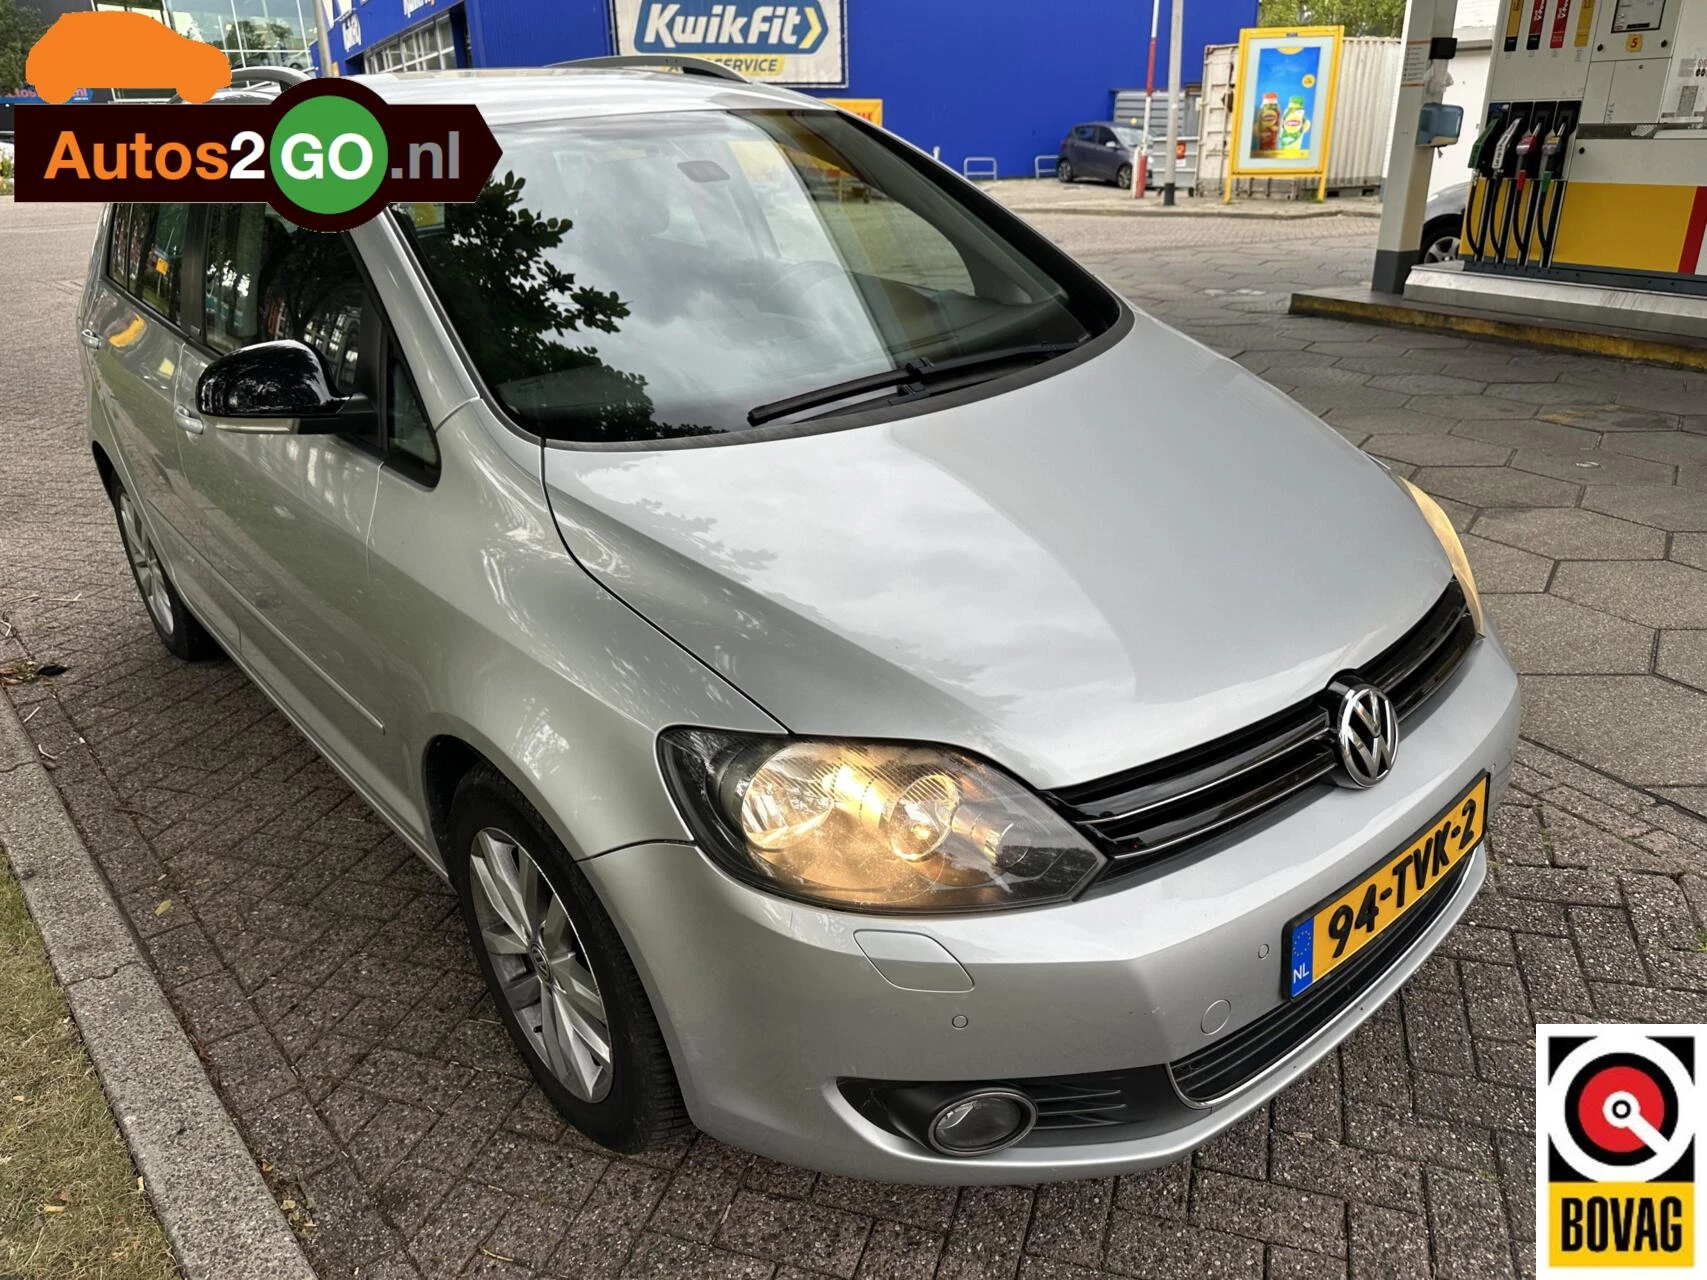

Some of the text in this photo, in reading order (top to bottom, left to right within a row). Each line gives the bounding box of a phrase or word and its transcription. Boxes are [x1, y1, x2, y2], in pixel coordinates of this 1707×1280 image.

[1629, 37, 1639, 49] 5
[1292, 797, 1477, 984] NL 94-TVK-2
